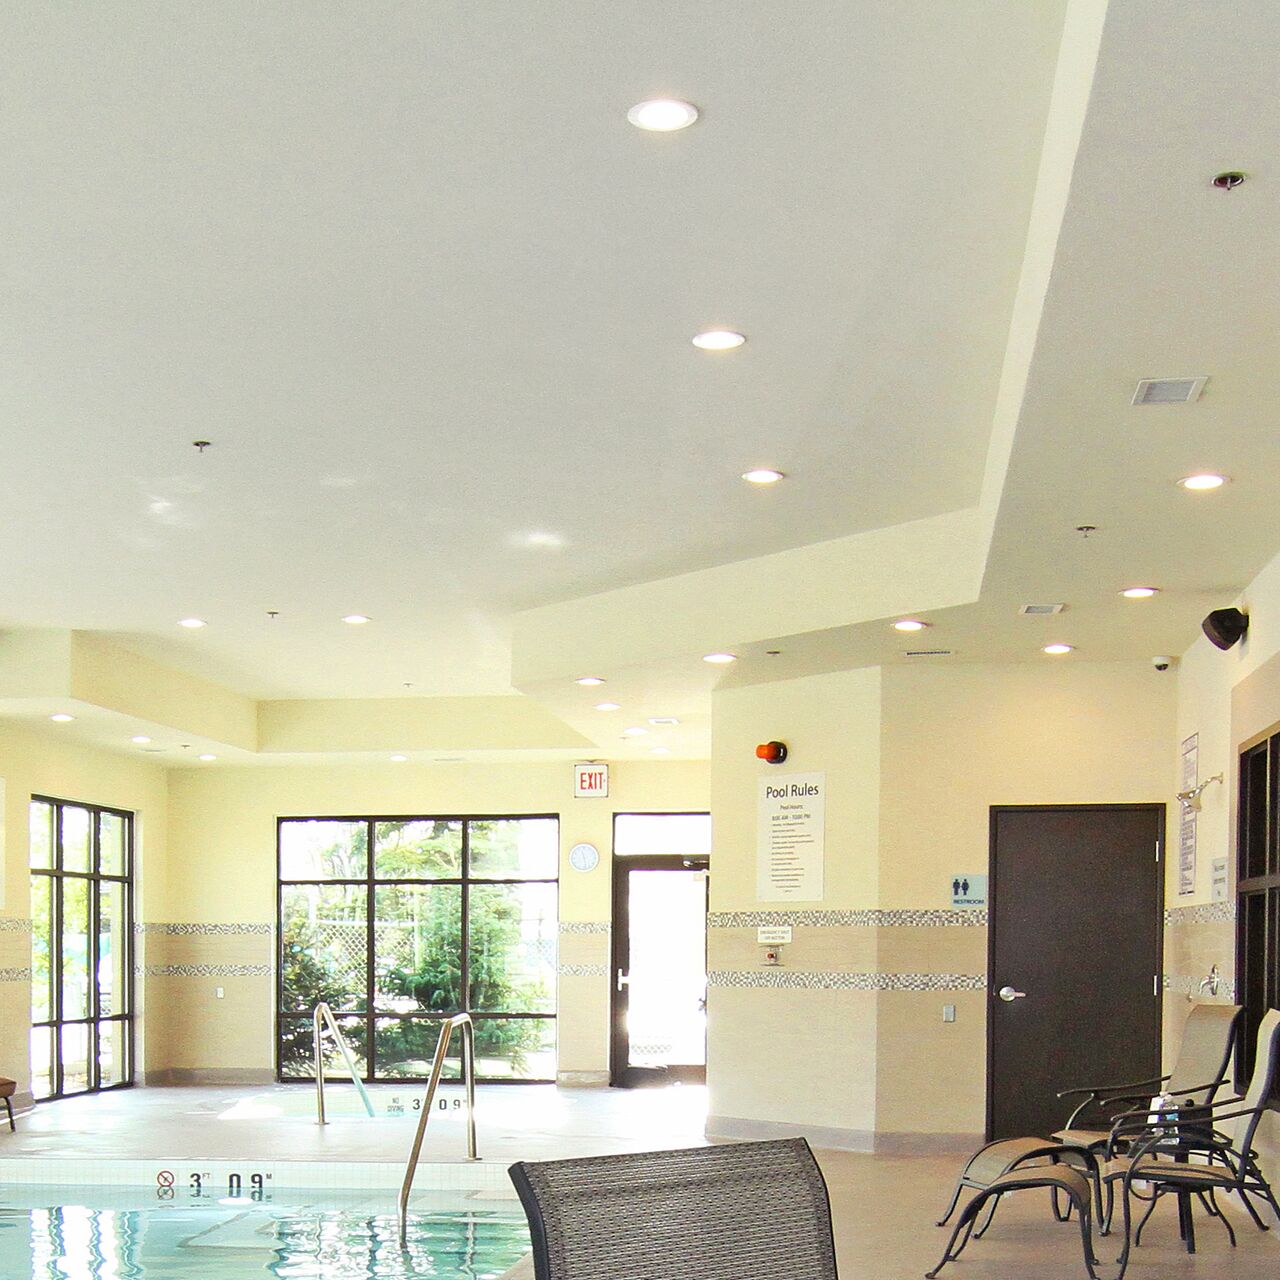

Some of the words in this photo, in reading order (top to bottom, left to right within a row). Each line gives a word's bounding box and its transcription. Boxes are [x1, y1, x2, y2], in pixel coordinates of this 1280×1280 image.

[580, 772, 604, 790] EXIT
[766, 784, 789, 799] Pool
[791, 782, 819, 797] Rules
